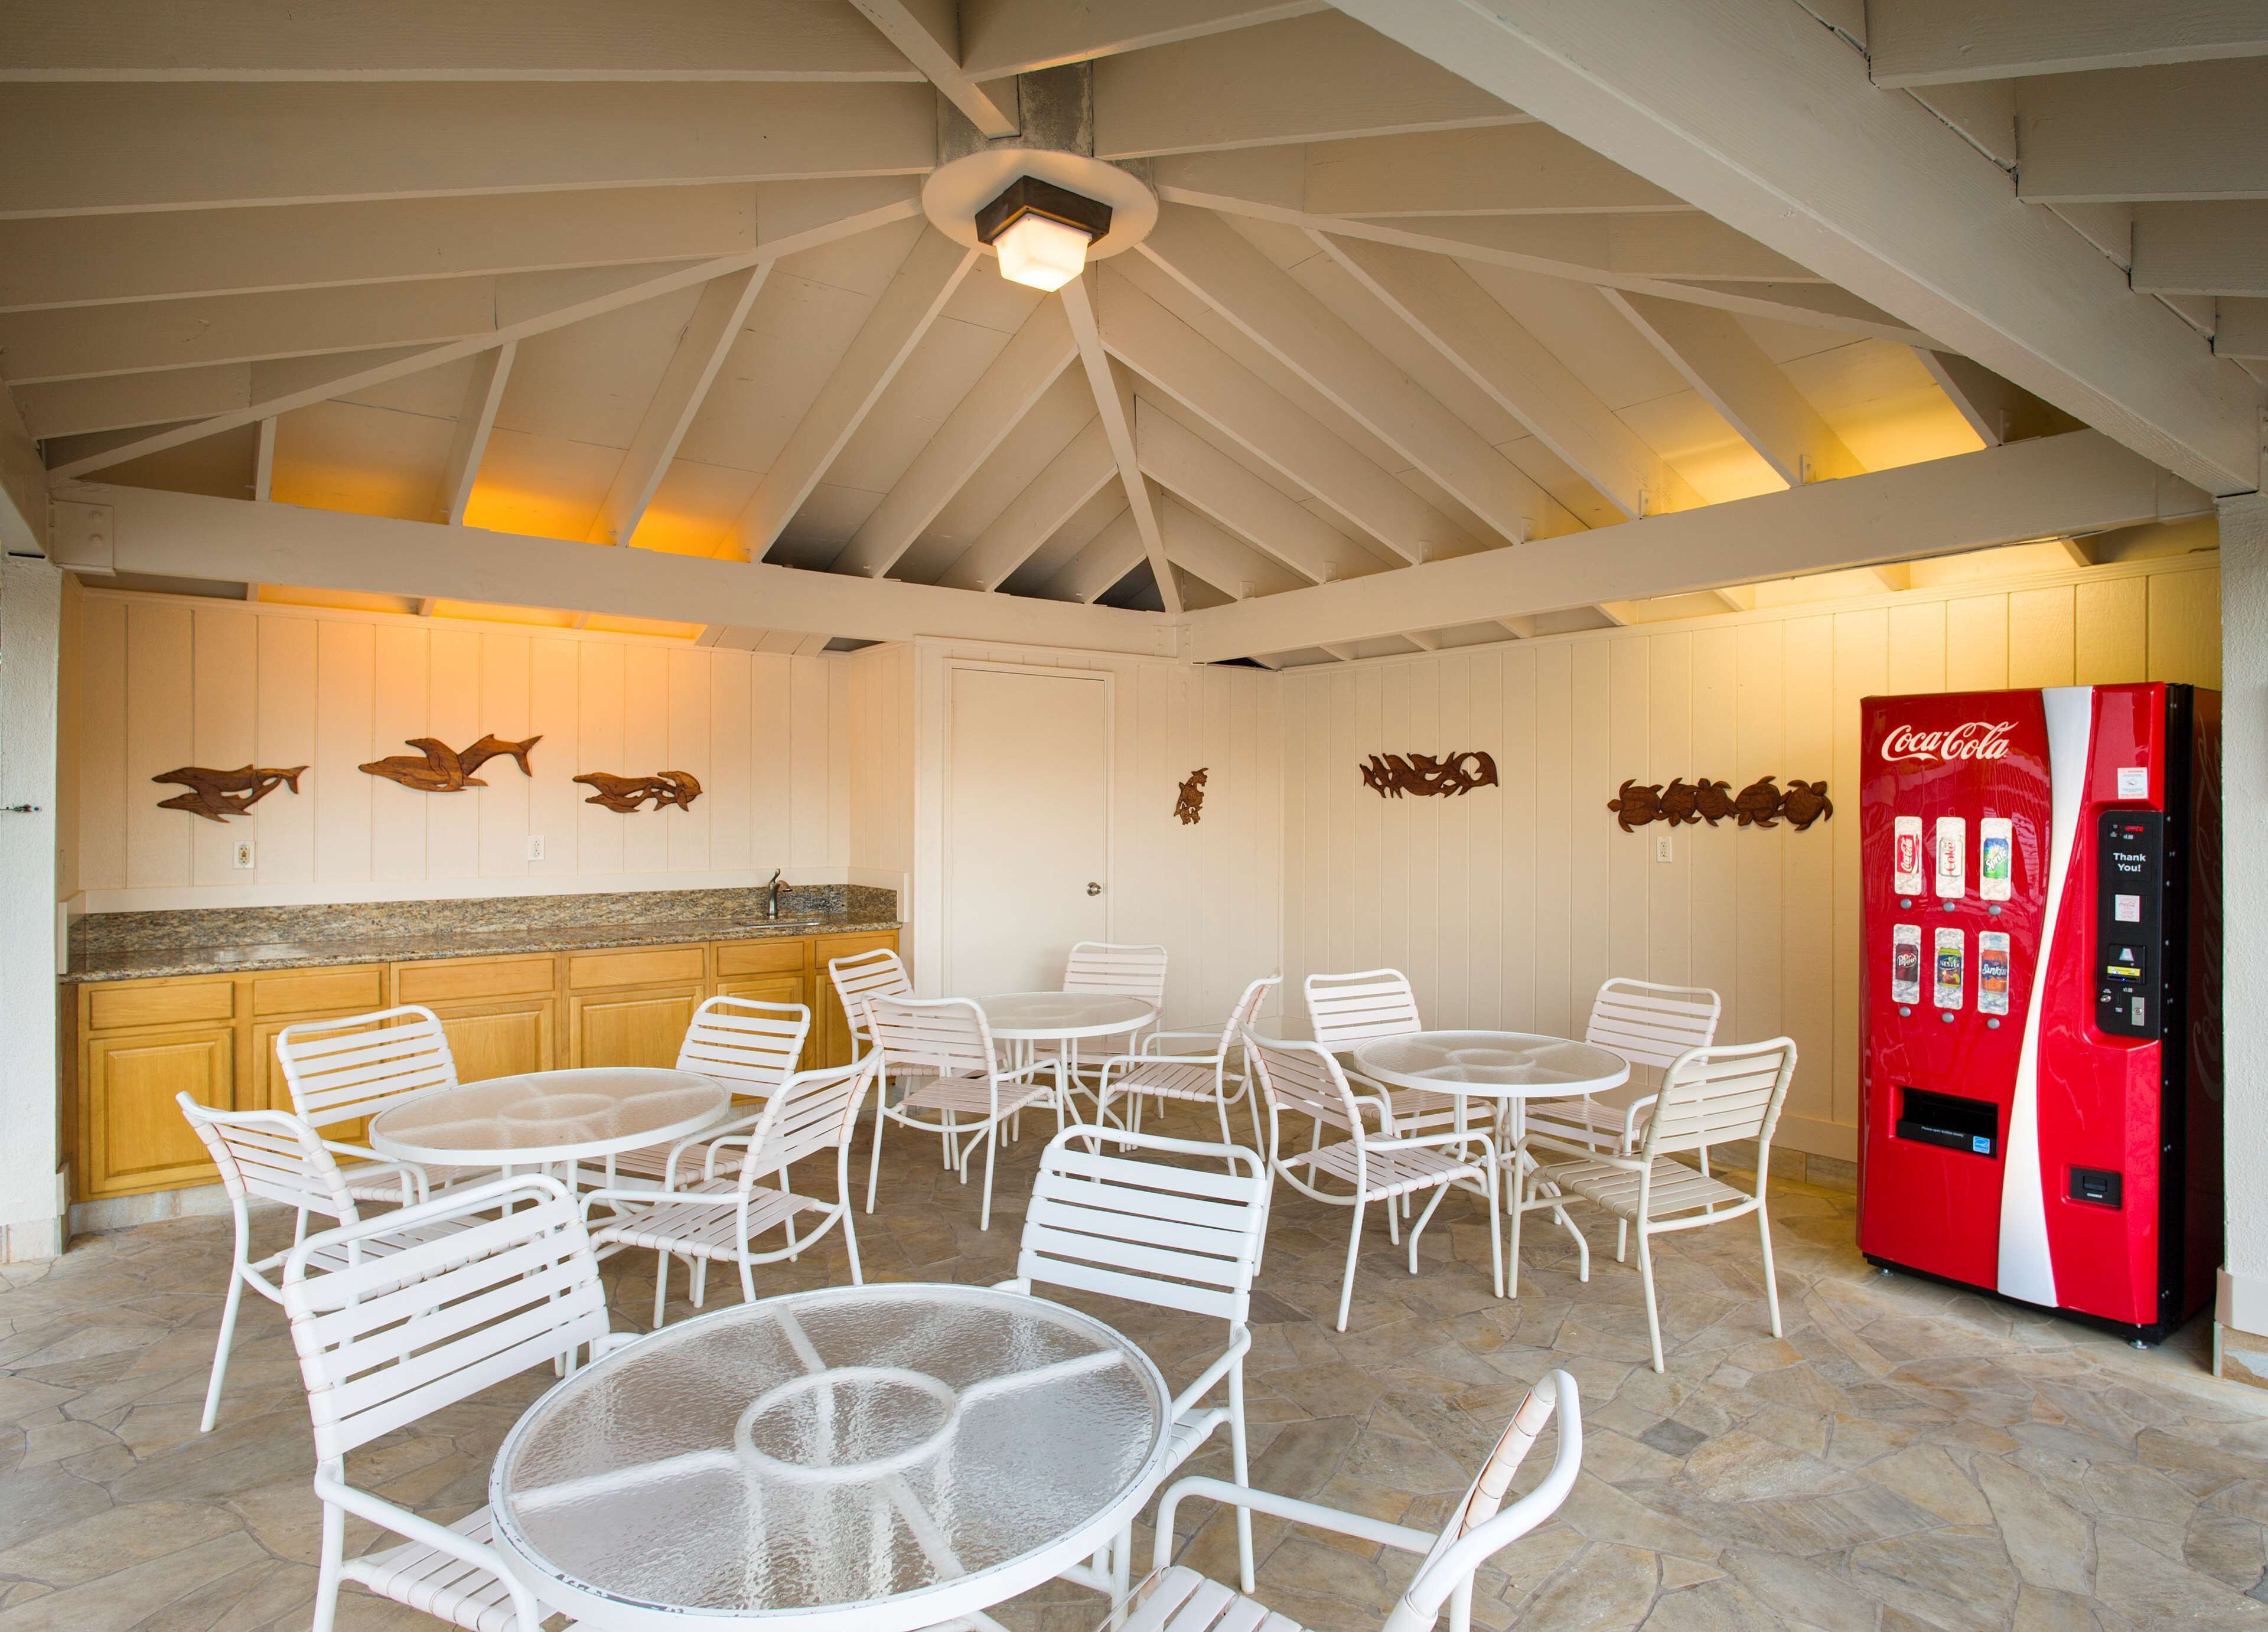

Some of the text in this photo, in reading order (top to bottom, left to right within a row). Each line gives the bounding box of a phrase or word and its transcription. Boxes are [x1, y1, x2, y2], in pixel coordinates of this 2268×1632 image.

[1881, 721, 2019, 762] Coca-Cola
[1944, 841, 1956, 872] Coke
[1985, 847, 2008, 871] Sprite
[2113, 853, 2146, 861] Thank
[2117, 863, 2141, 872] You!
[1896, 955, 1915, 967] Pepper
